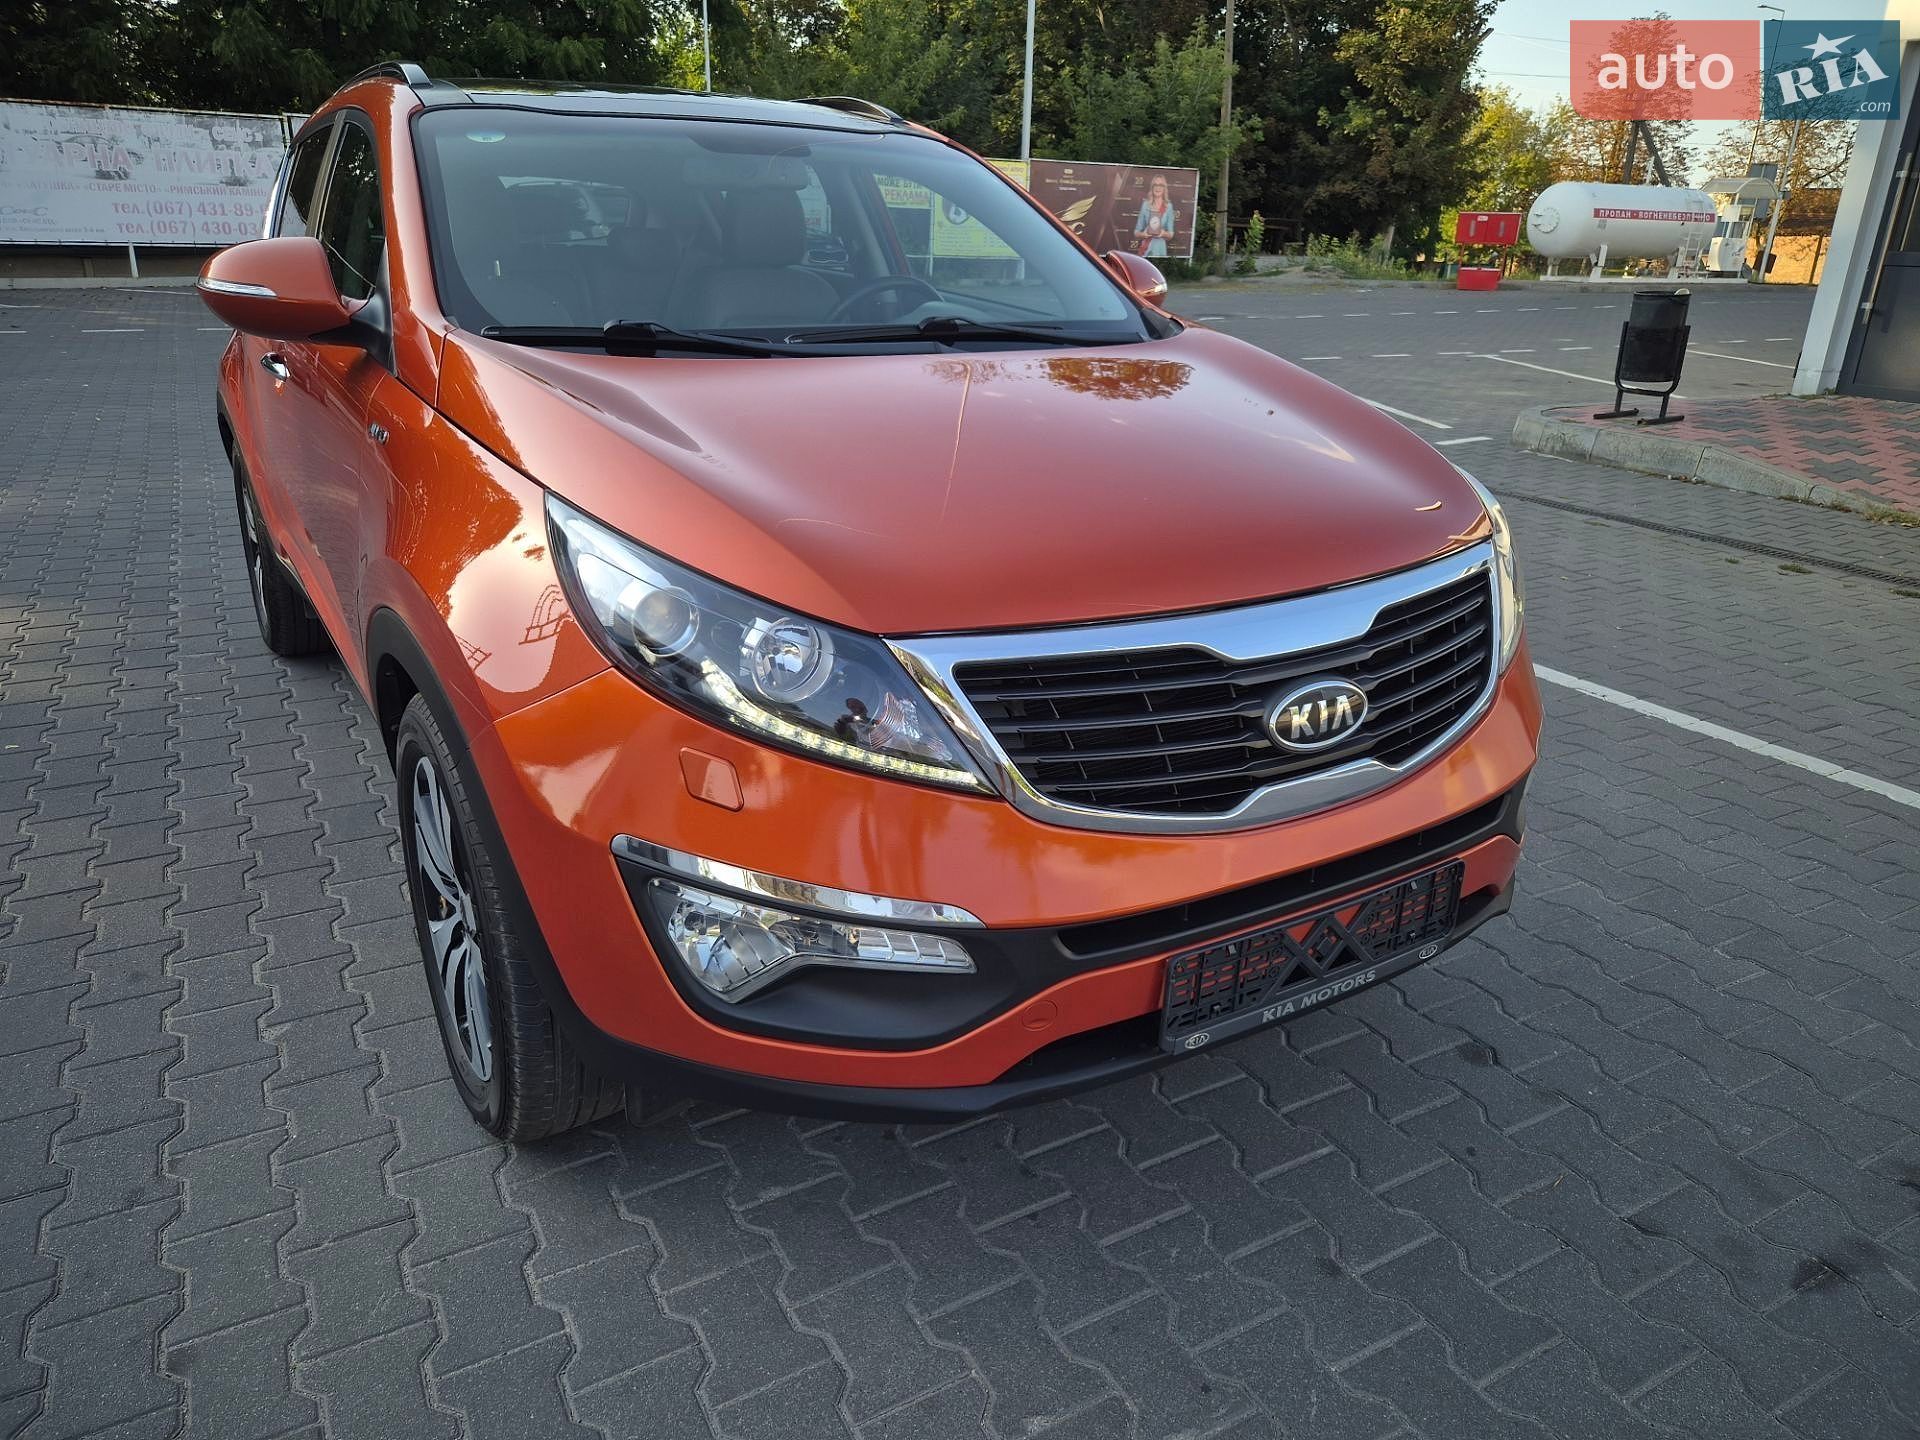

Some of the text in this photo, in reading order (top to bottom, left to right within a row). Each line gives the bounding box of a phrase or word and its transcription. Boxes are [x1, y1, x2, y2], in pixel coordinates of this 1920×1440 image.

[1599, 209, 1631, 218] ПРОПАН
[1287, 693, 1355, 740] KIA
[1261, 970, 1377, 1023] KIA MOTORS
